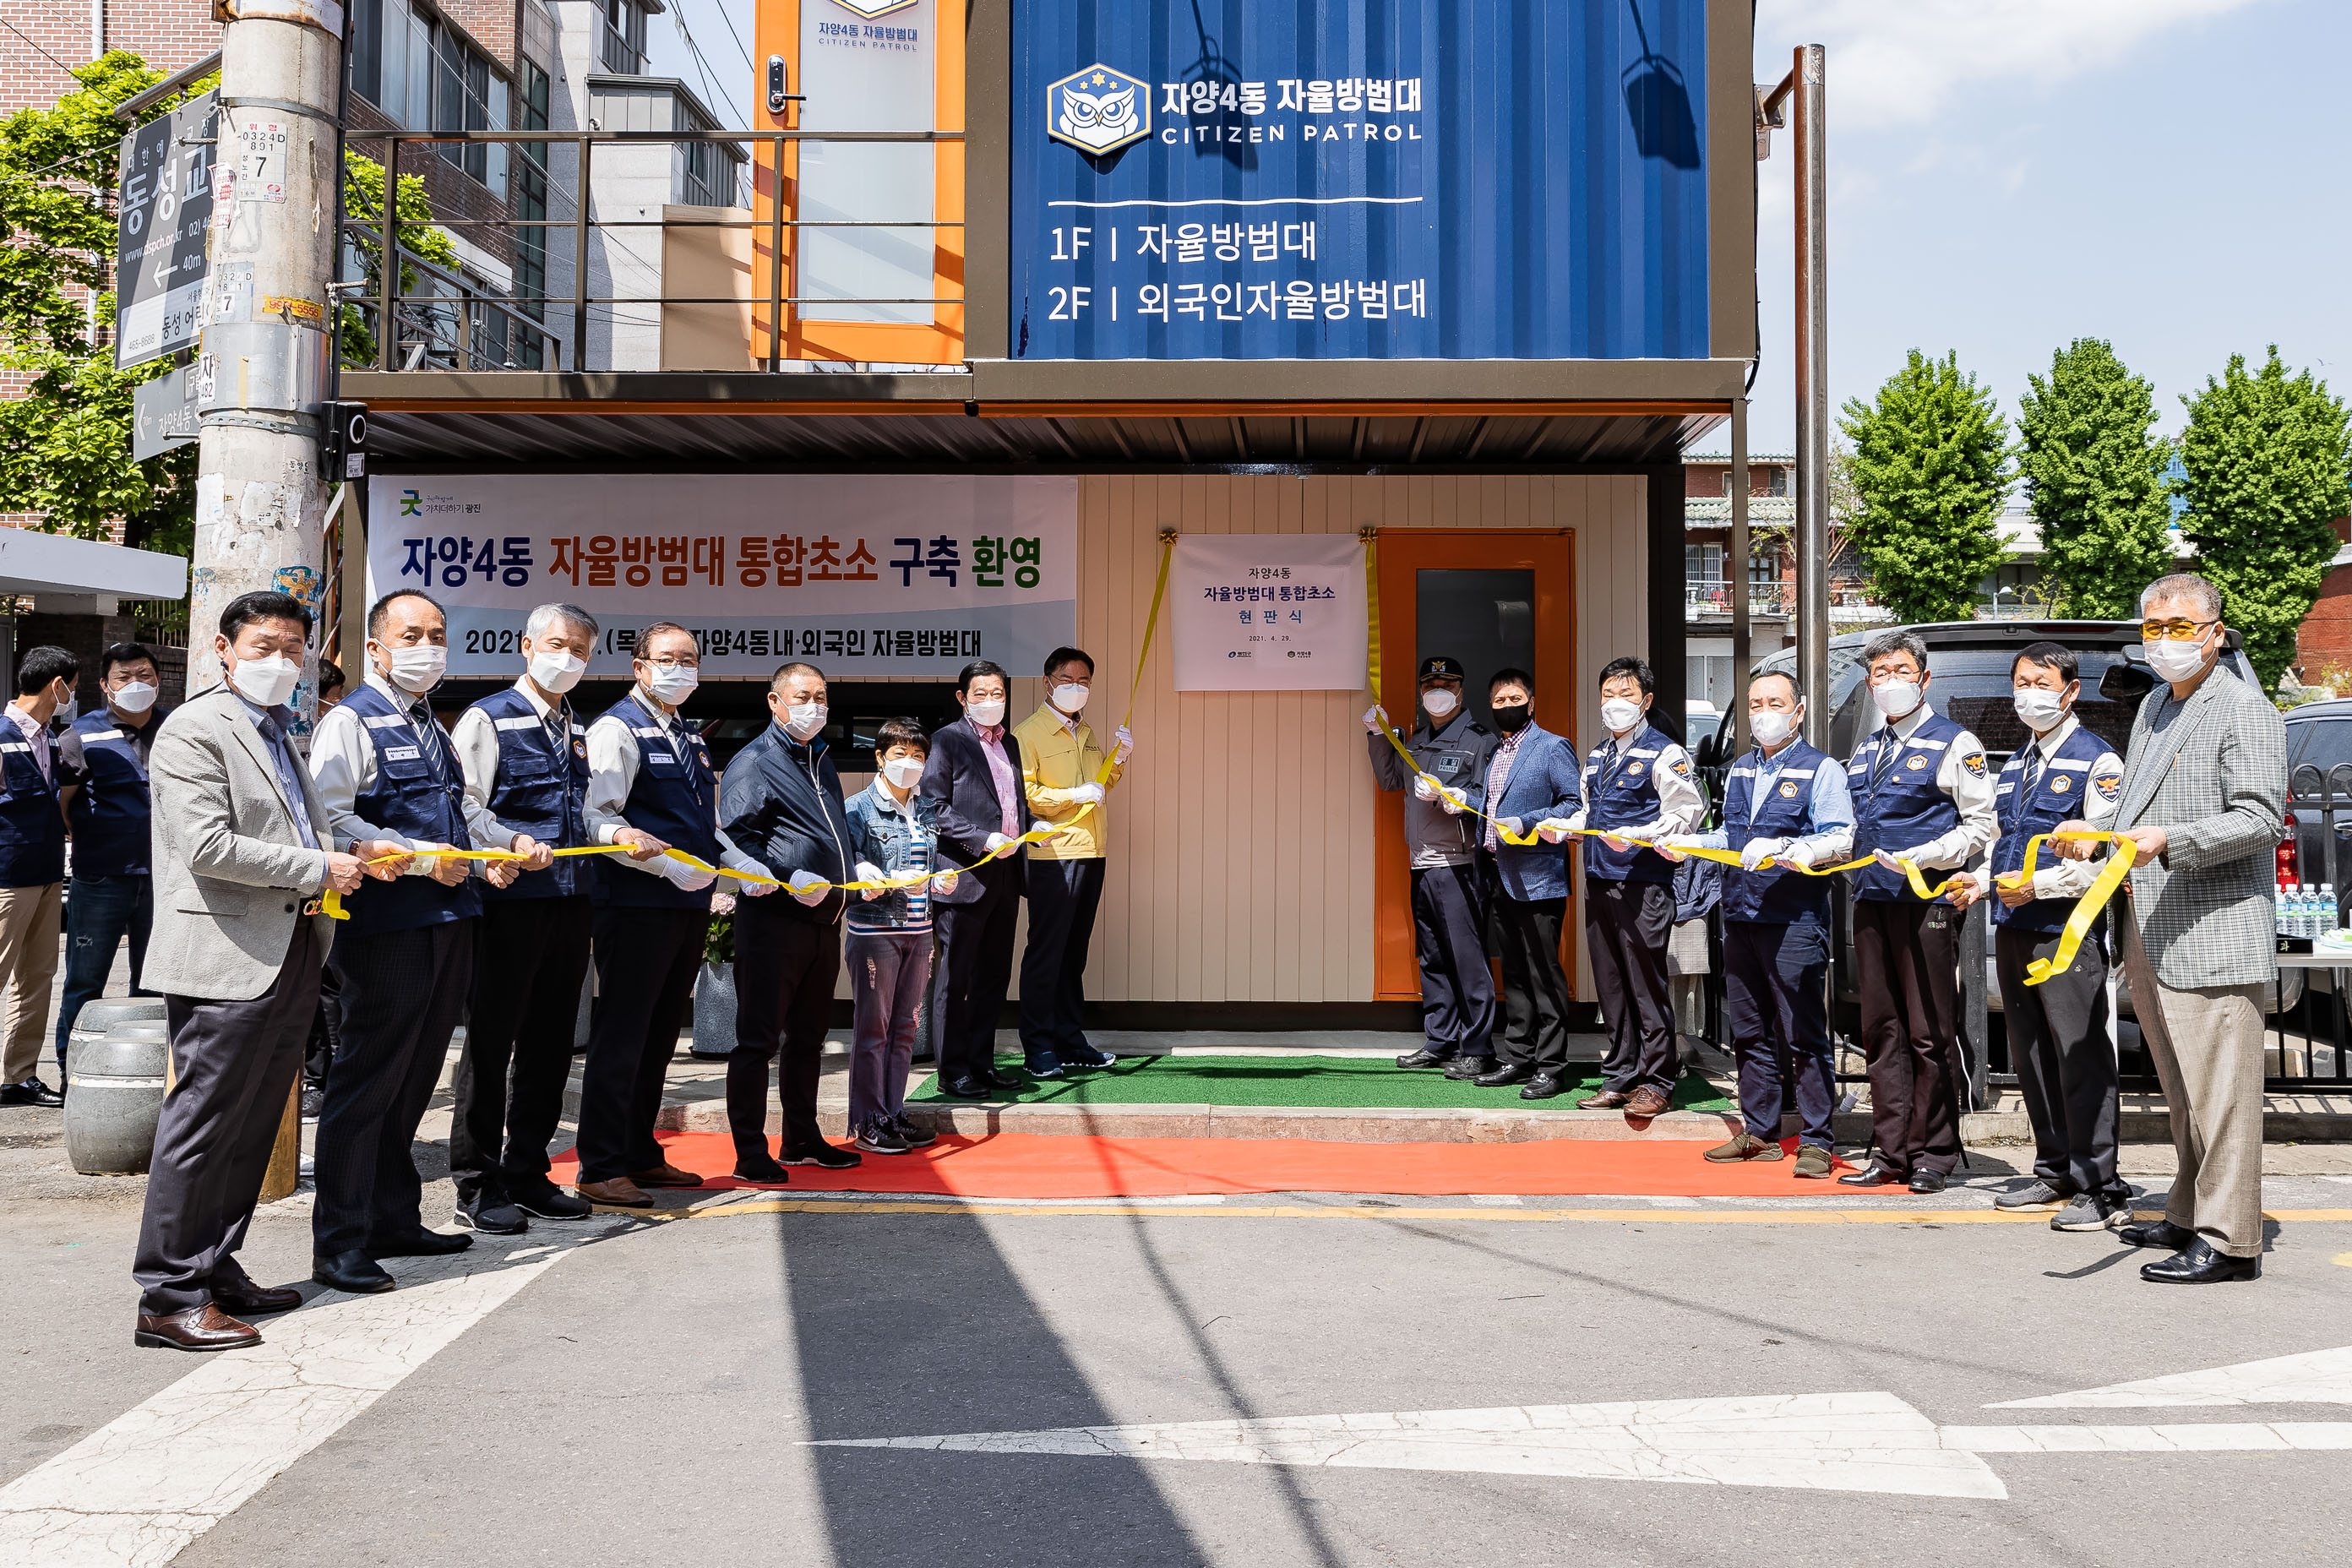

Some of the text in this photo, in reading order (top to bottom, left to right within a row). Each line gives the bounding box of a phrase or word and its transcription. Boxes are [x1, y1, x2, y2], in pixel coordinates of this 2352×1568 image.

[819, 22, 918, 42] 자양4동 자율방범대
[818, 38, 917, 52] CITIZEN PATROL
[1161, 77, 1422, 116] 자양4동 자율방범대
[242, 132, 286, 143] 0324D
[1161, 122, 1422, 144] CITIZEN PATROL
[250, 142, 273, 151] 891
[256, 156, 267, 177] 7
[1050, 226, 1092, 261] 1F
[1136, 220, 1315, 264] 자율방범대
[182, 253, 201, 272] 40m
[224, 296, 232, 311] 7
[1047, 286, 1092, 321] 2F
[1136, 278, 1425, 324] 외국인자율방범대
[425, 504, 481, 514] 가치더하기 광진
[400, 532, 1041, 589] 자양4동 자율방범대 통합초소 구축 환영
[1248, 567, 1292, 580] 자양4동
[1203, 585, 1336, 602] 자율방범대 통합초소
[872, 629, 982, 657] 자율방범대
